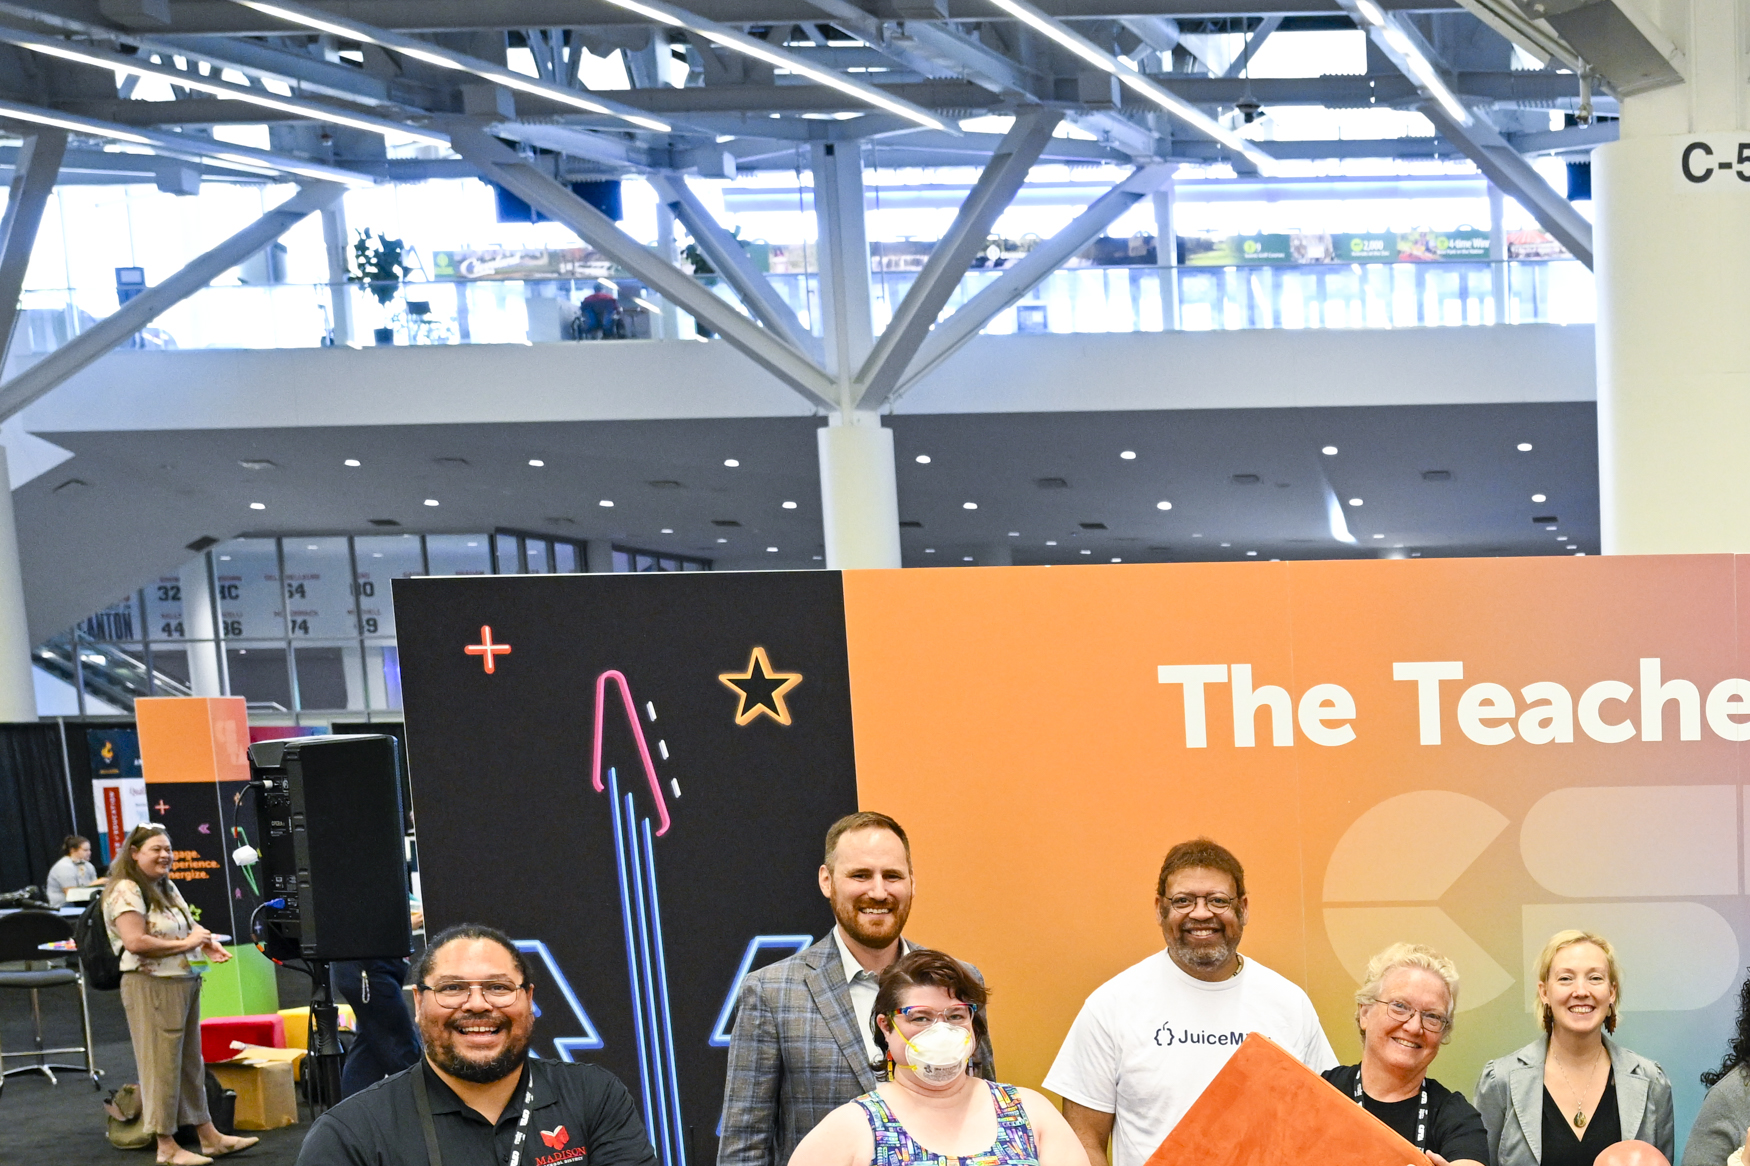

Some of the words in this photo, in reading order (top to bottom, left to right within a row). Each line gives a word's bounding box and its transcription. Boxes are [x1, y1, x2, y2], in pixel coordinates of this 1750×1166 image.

[157, 585, 182, 601] 32
[1156, 662, 1358, 749] The
[168, 870, 210, 881] nergize.
[535, 1146, 587, 1166] MADISON
[564, 1156, 583, 1165] DISTRICT
